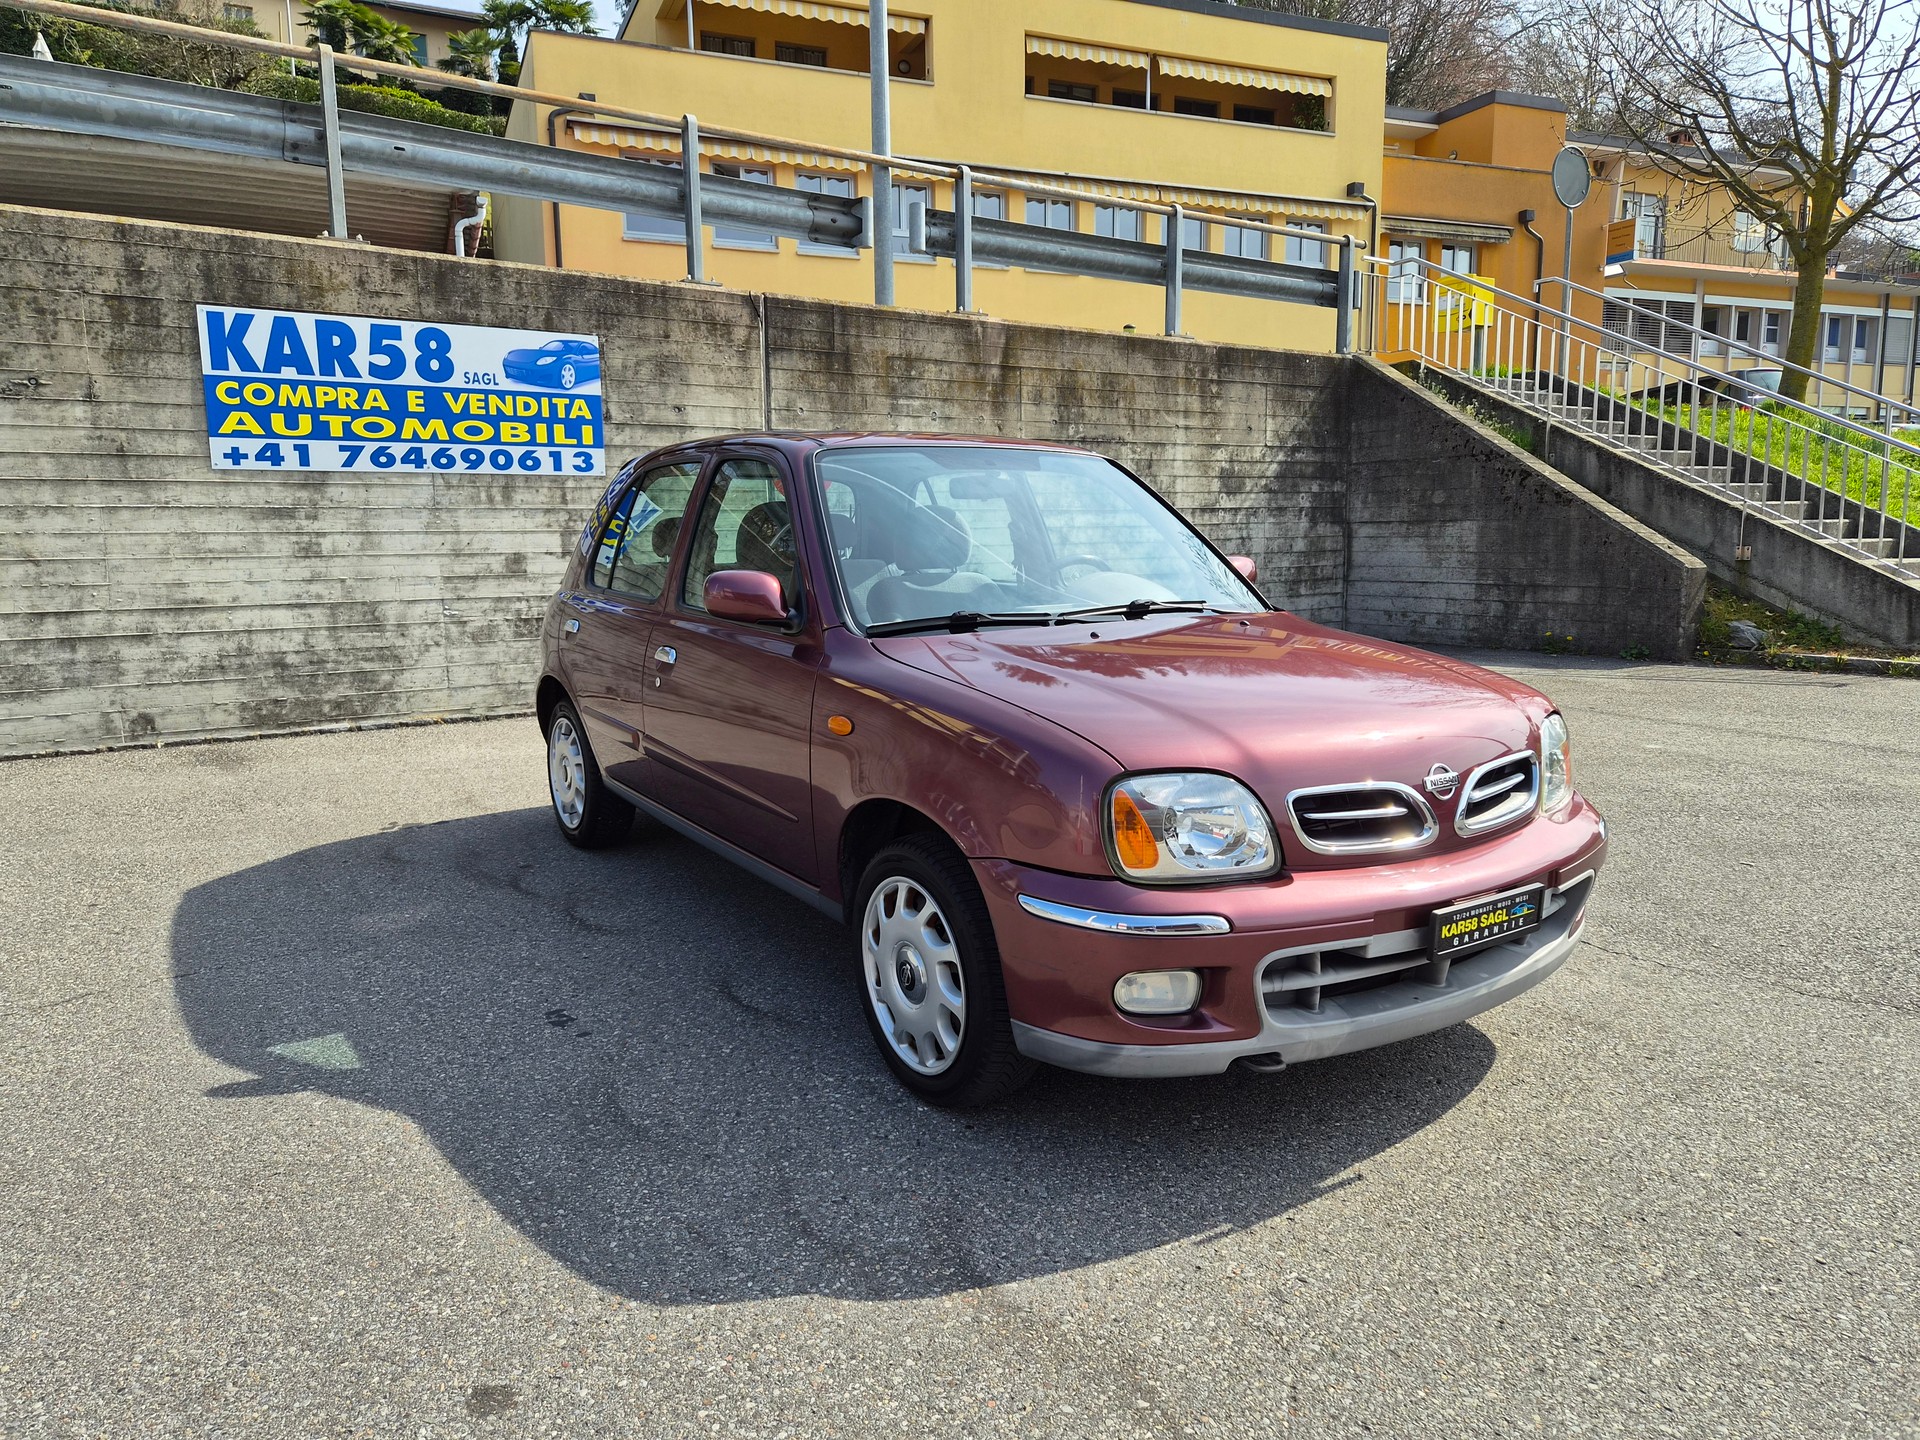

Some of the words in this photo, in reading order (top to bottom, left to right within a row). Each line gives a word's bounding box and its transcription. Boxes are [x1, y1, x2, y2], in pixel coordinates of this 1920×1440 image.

[206, 311, 455, 384] KAR58
[463, 371, 499, 386] SAGL
[215, 380, 390, 411] COMPRA
[407, 390, 426, 413] E
[444, 392, 593, 420] VENDITA
[218, 411, 595, 446] AUTOMOBILI
[223, 443, 311, 468] +41
[338, 444, 595, 473] 764690613
[1430, 775, 1459, 787] NISSAN
[1453, 911, 1470, 921] 12/24
[1470, 904, 1493, 916] MONATE
[1497, 899, 1511, 909] MOIS
[1515, 894, 1529, 903] MESI
[1441, 917, 1478, 939] KAR58
[1480, 908, 1509, 928] SAGL
[1453, 917, 1524, 946] GARANTIE
